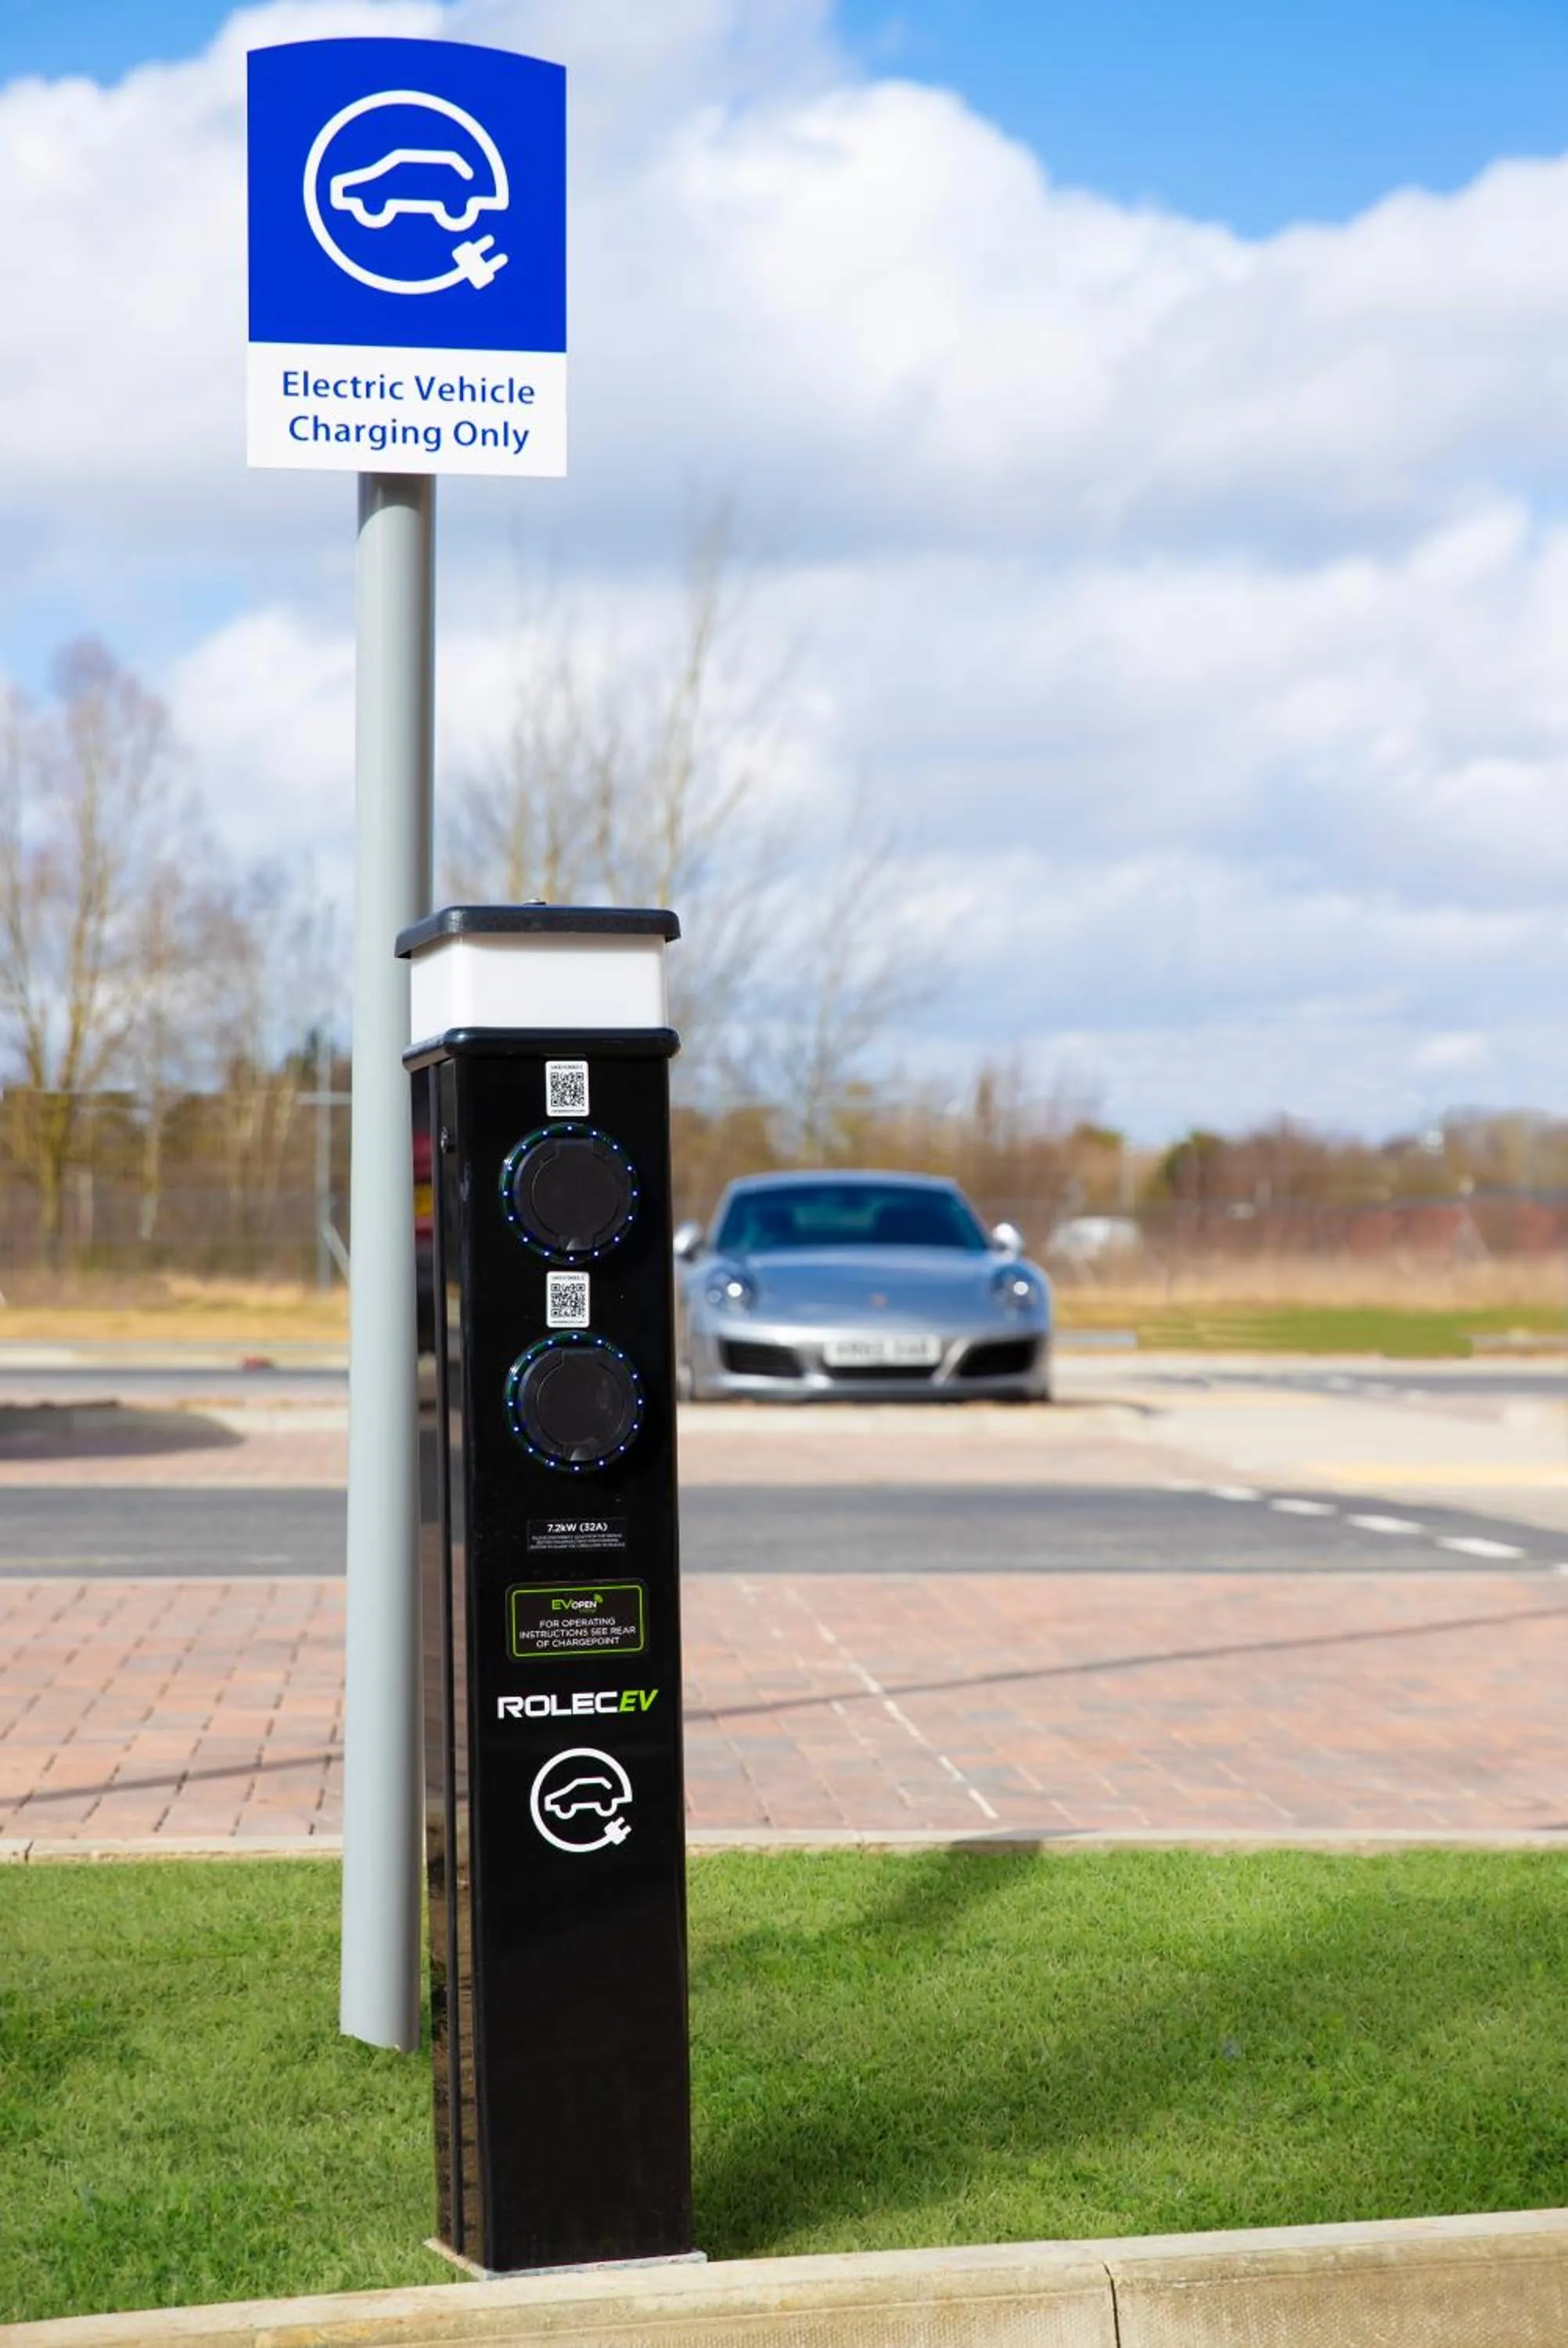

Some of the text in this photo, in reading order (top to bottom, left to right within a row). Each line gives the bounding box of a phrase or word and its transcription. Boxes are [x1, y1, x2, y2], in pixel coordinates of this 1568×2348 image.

[282, 371, 535, 405] Electric Vehicle
[289, 415, 530, 455] Charging Only
[547, 1522, 608, 1532] 7.2kW (32A)
[539, 1616, 616, 1629] FOR OPERATING
[520, 1625, 637, 1640] INSTRUCTIONS SEE REAR
[536, 1637, 620, 1648] OF CHARGEPOINT
